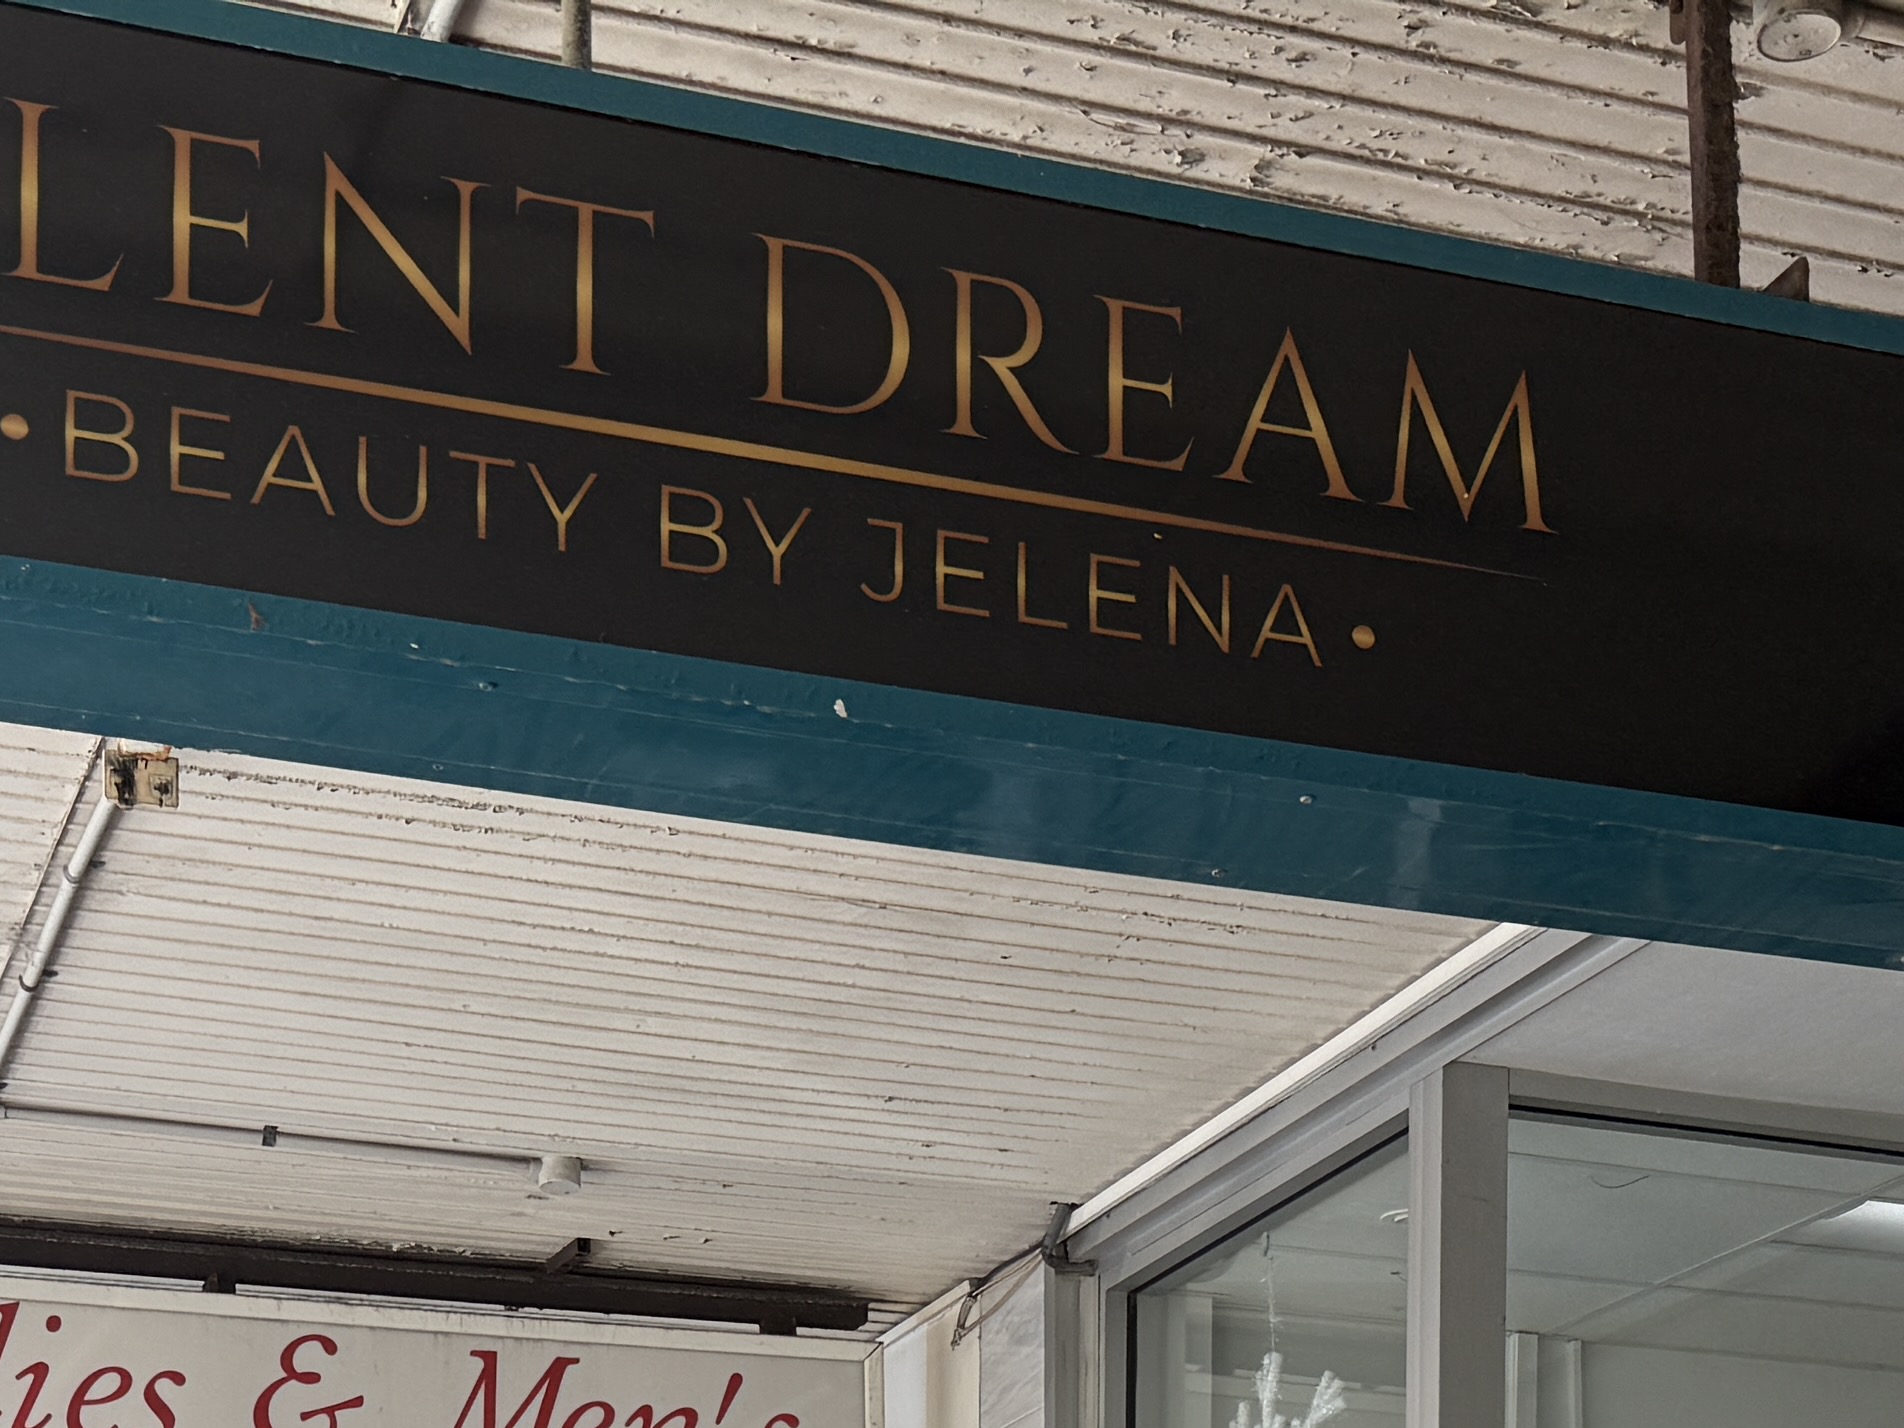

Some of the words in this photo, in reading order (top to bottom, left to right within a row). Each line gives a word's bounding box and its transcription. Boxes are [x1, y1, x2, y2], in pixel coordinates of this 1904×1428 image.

[60, 388, 602, 557] BEAUTY
[658, 484, 806, 590] BY
[858, 514, 1327, 670] JELENA
[751, 230, 1561, 535] DREAM
